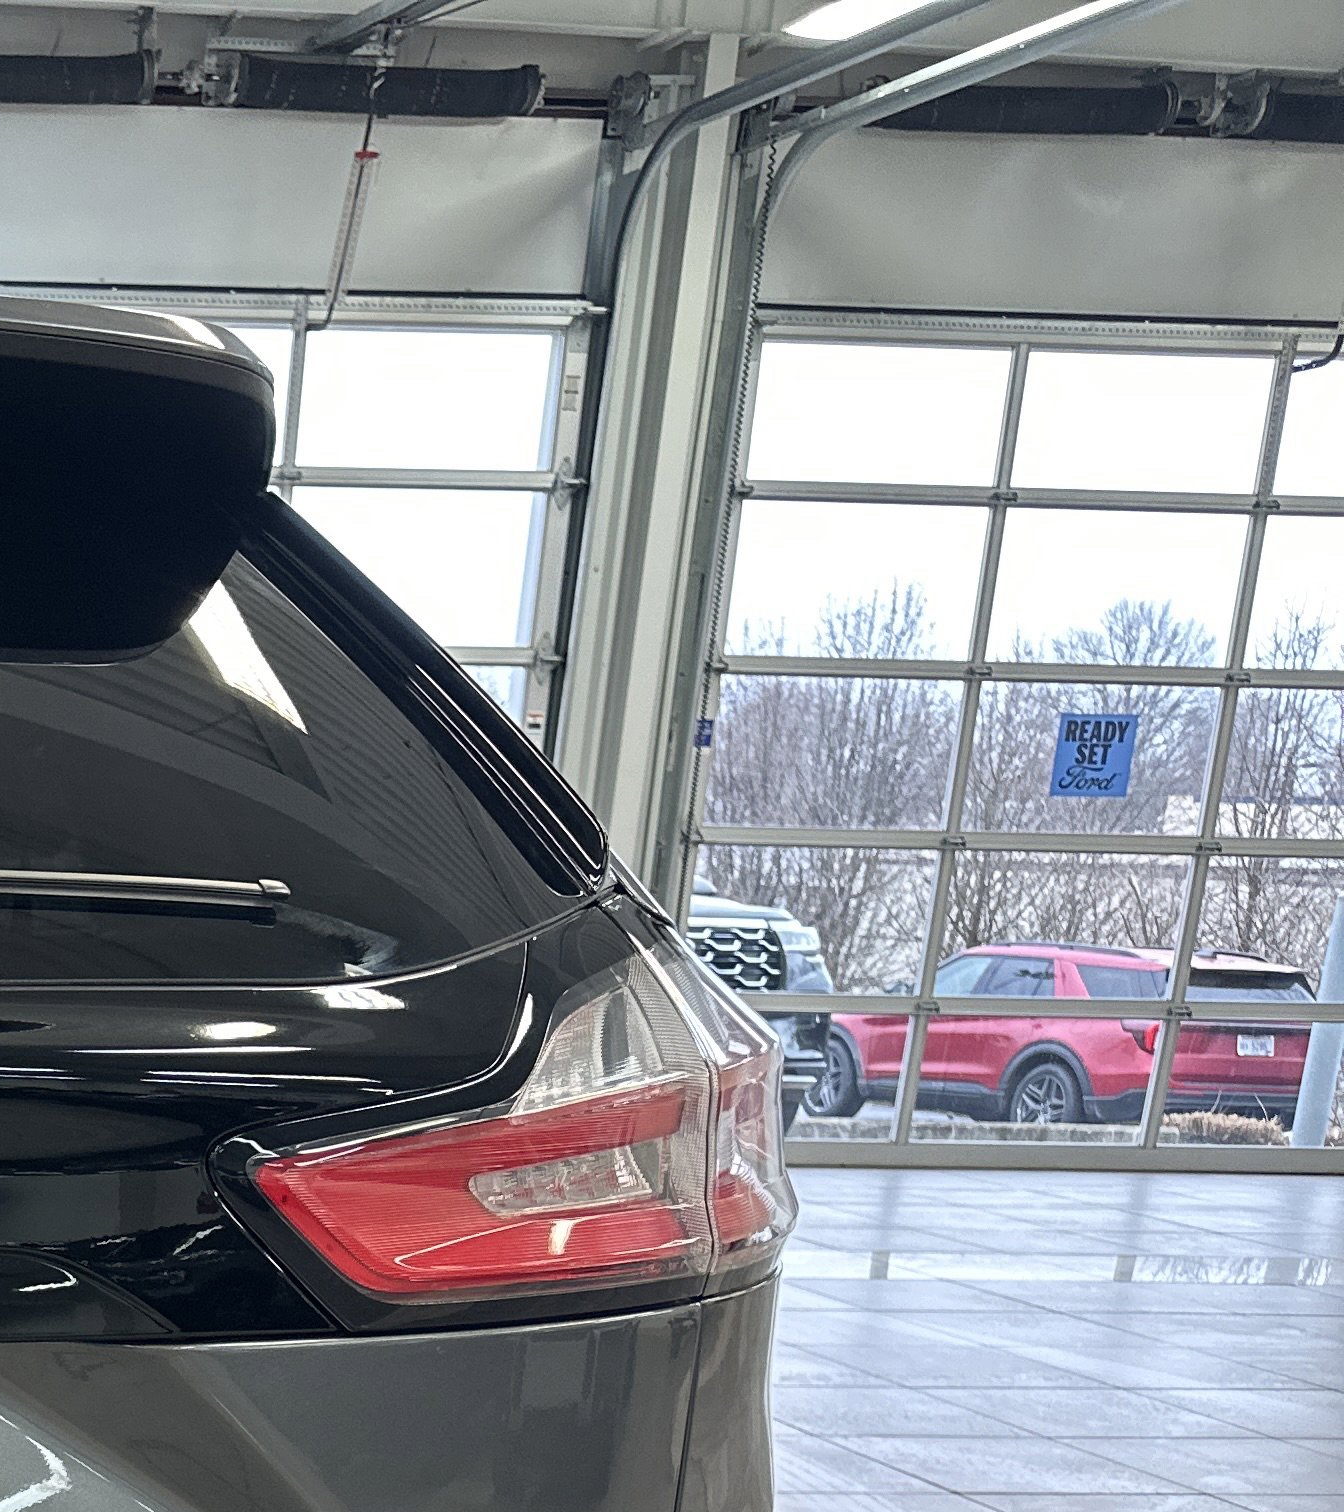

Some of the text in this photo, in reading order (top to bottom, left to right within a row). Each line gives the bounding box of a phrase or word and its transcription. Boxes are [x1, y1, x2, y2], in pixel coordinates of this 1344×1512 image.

[1065, 720, 1130, 743] READY
[1074, 743, 1112, 765] SET
[1058, 764, 1118, 791] Ford
